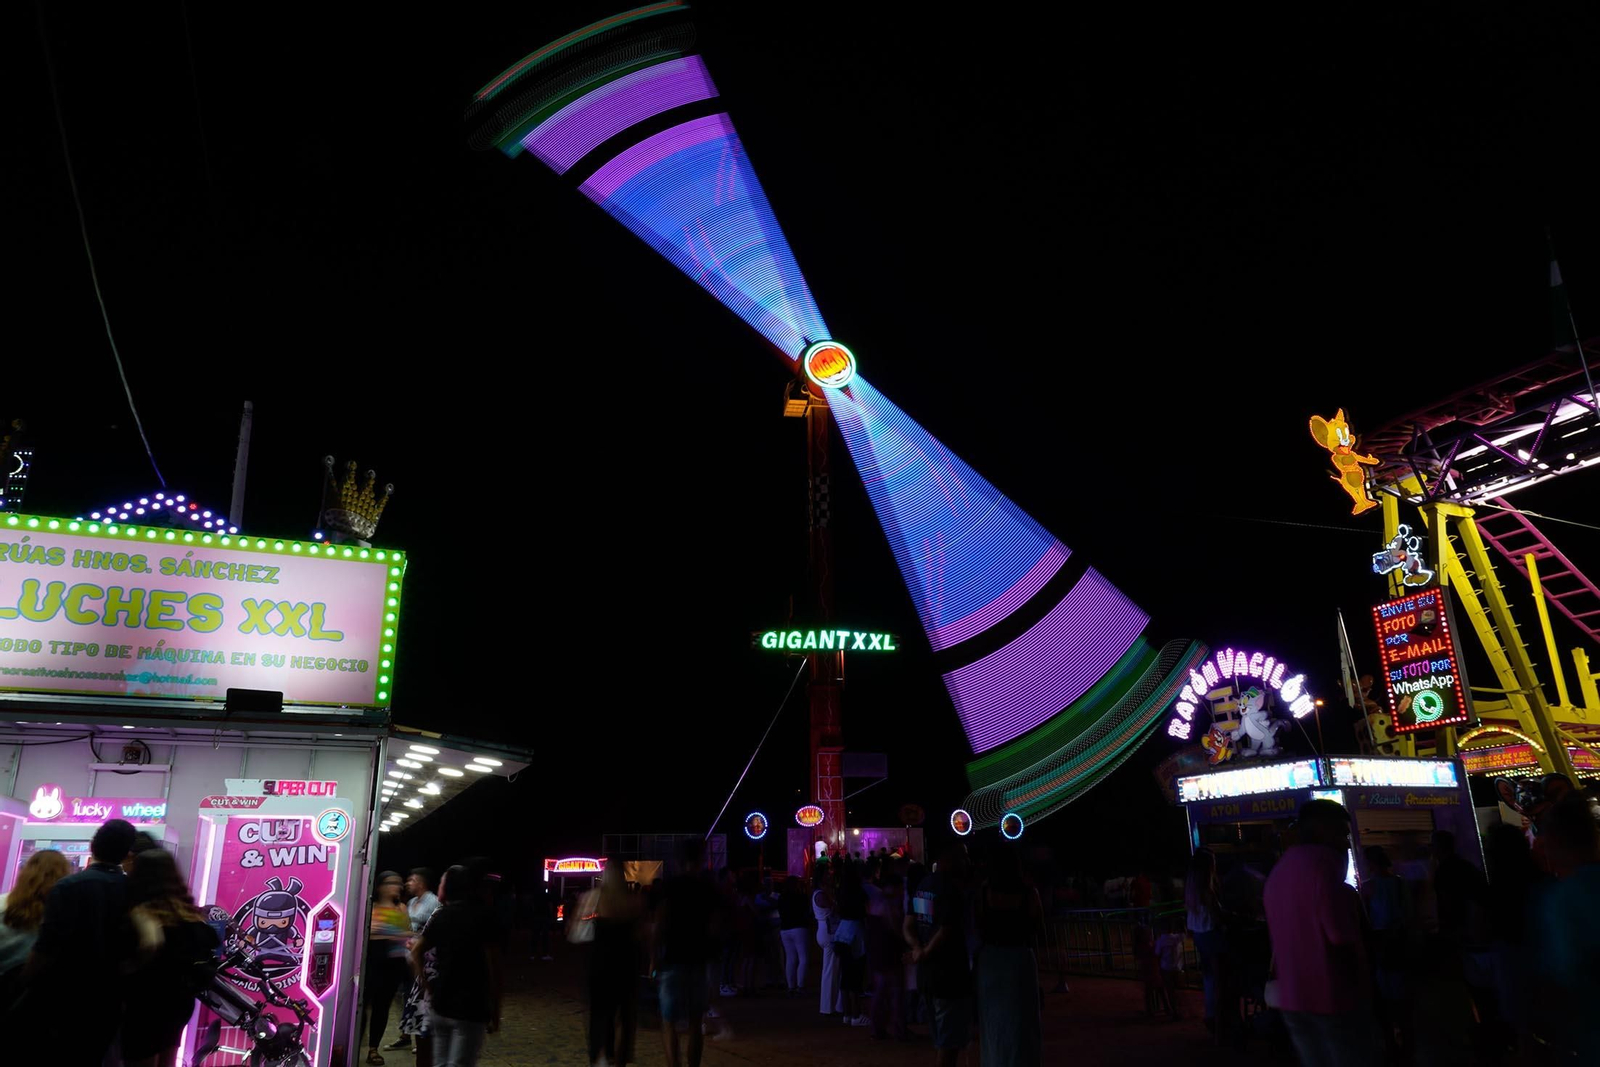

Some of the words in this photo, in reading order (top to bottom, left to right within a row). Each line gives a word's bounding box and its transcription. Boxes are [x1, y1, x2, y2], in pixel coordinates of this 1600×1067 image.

[72, 549, 152, 573] HNOS.
[159, 550, 281, 584] SÁNCHEZ
[238, 598, 345, 641] XXL
[1380, 600, 1415, 618] ENVIE
[1383, 614, 1416, 634] FOTO
[1385, 633, 1409, 646] POR
[1388, 638, 1447, 662] E-MAIL
[0, 638, 42, 653] ODO
[48, 640, 100, 657] TIPO
[104, 644, 133, 659] DE
[137, 639, 226, 664] MÁQUINA
[230, 652, 257, 666] EN
[261, 653, 286, 668] SU
[290, 655, 369, 673] NEGOCIO
[1390, 669, 1402, 681] SU
[1402, 660, 1430, 679] FOTO
[1430, 658, 1452, 673] POR
[1391, 674, 1455, 695] WhatsApp
[262, 780, 306, 796] SUPER
[307, 781, 338, 796] CUT
[73, 802, 113, 819] lucky
[122, 802, 167, 817] wheel
[210, 798, 229, 806] CUT
[238, 819, 301, 844] CUT
[240, 848, 265, 868] &
[268, 843, 329, 867] WIN
